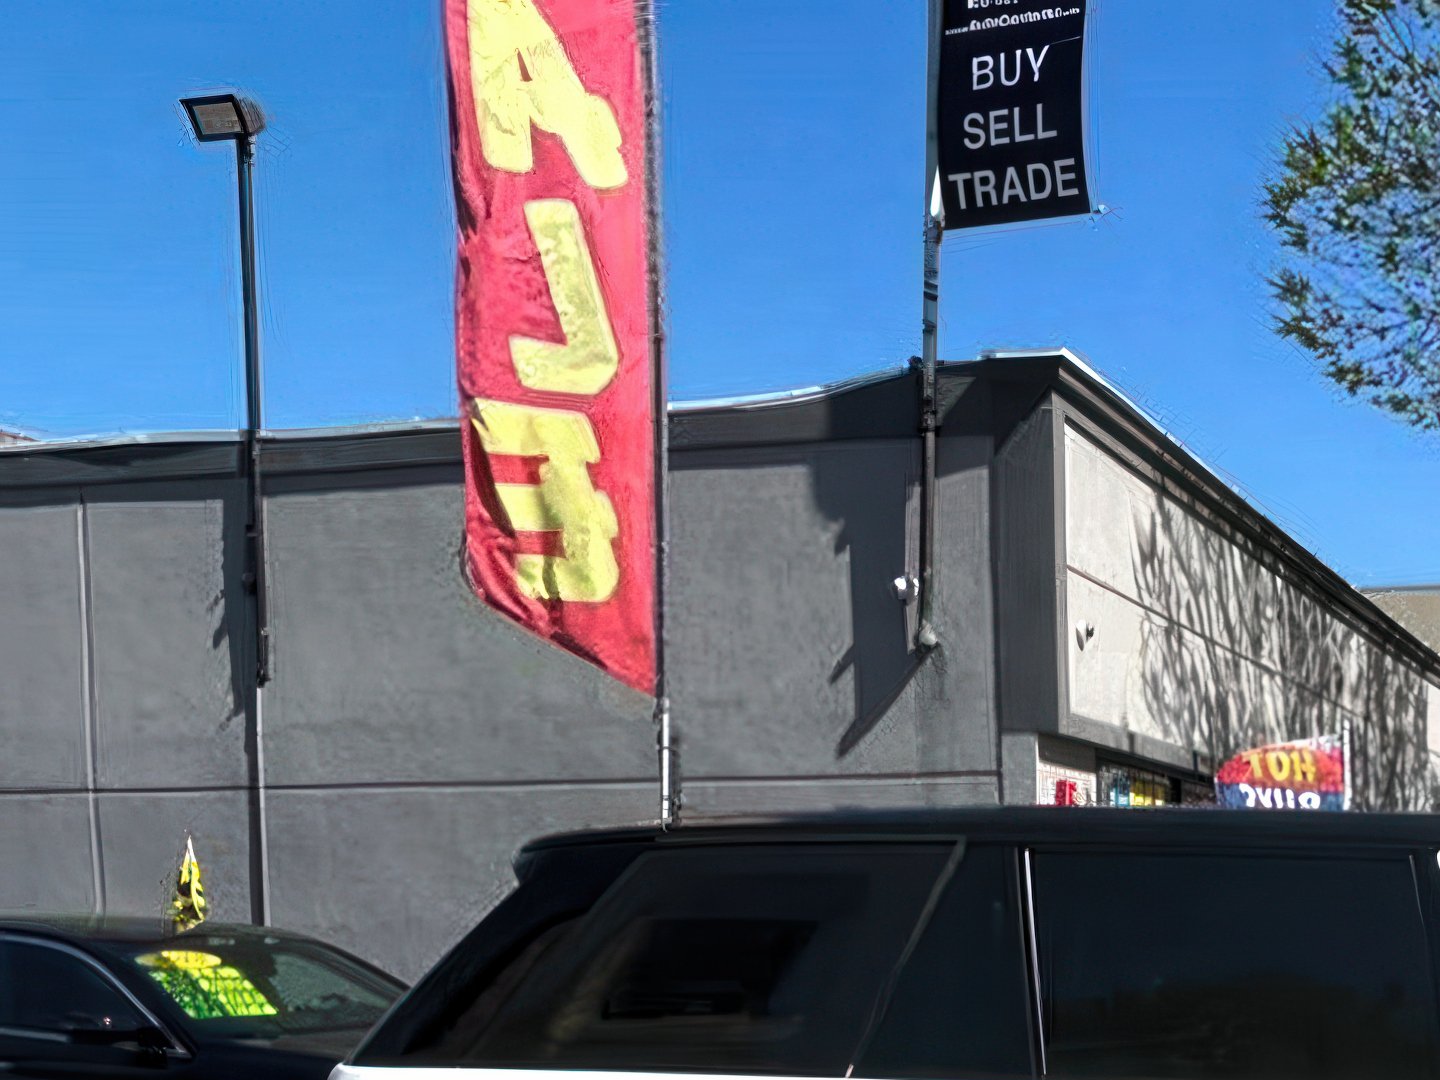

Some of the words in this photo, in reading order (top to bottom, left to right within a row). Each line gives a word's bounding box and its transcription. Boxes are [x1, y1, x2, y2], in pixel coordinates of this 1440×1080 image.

[971, 45, 1050, 91] BUY
[963, 103, 1058, 150] SELL
[948, 157, 1079, 210] TRADE
